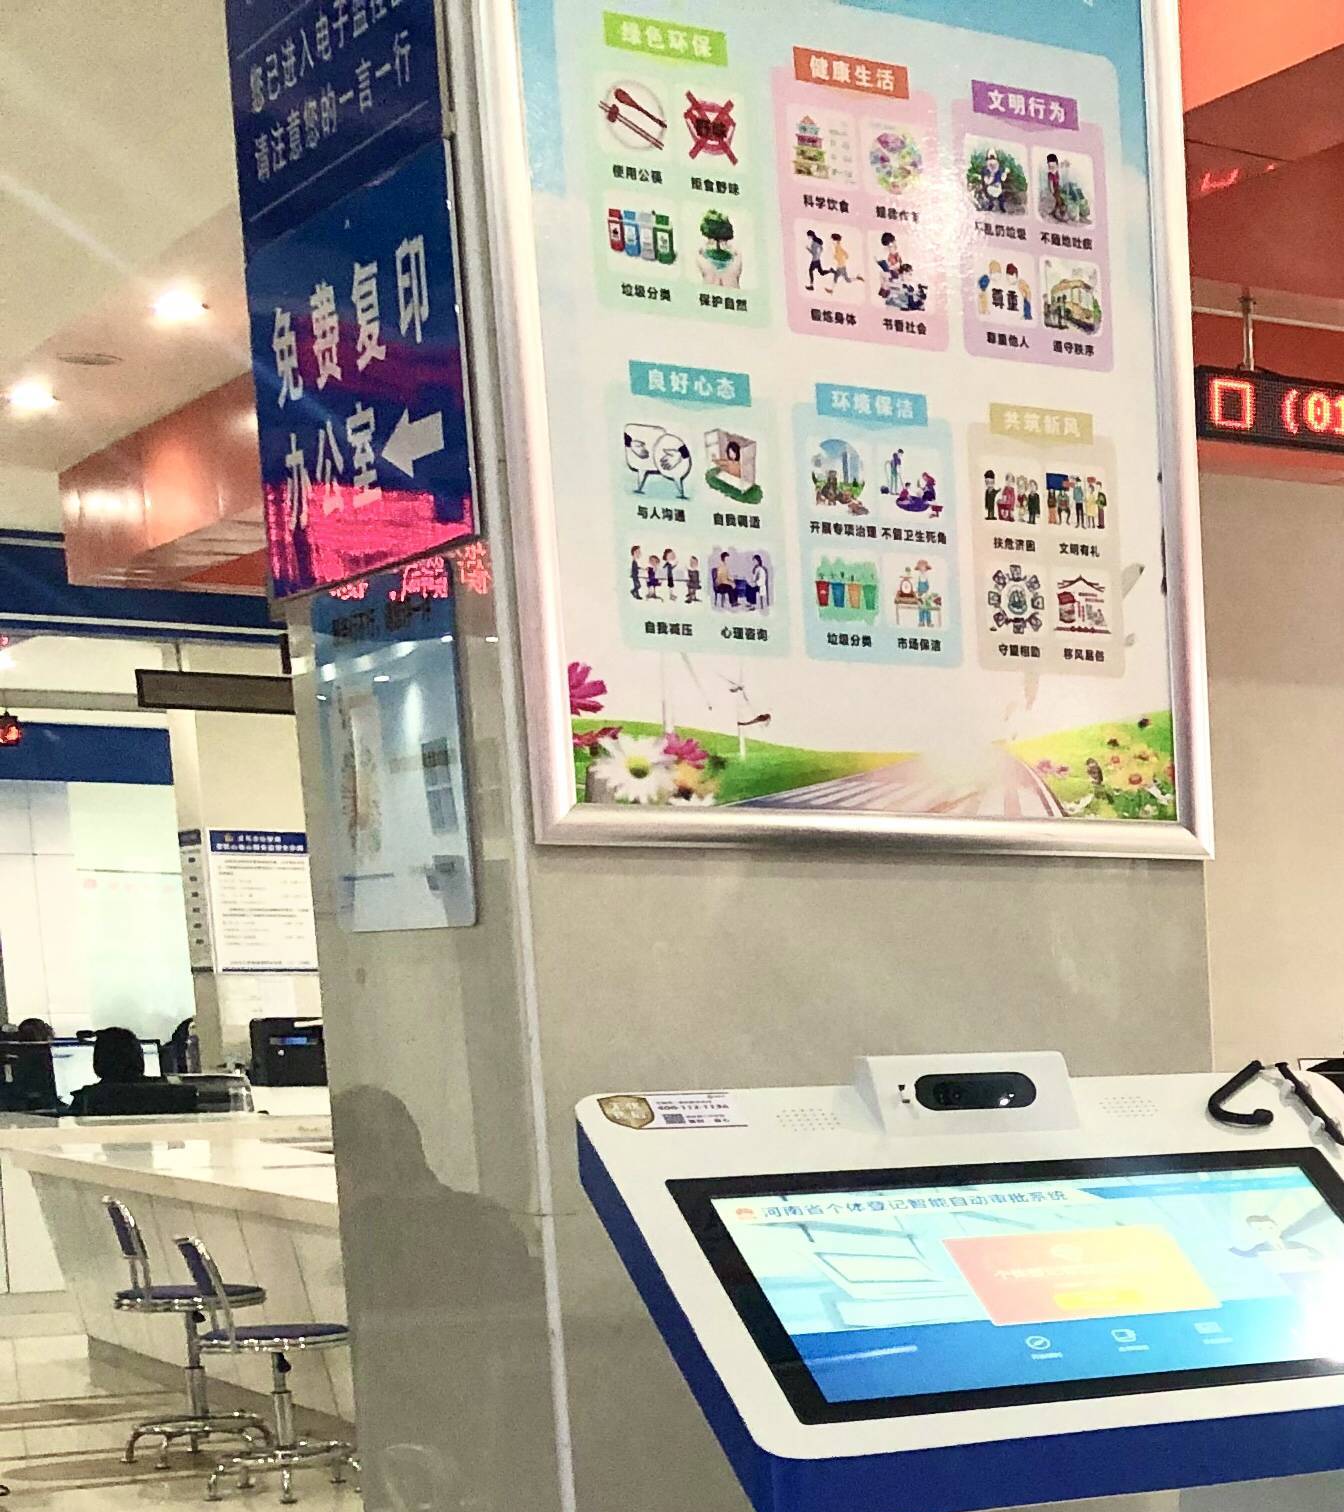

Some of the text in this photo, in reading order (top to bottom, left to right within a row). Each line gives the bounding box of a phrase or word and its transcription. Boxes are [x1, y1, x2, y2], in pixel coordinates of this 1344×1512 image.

[621, 21, 712, 57] 绿色环保
[809, 55, 896, 92] 健康生活
[255, 30, 411, 182] 请注意您的一言一行
[988, 90, 1066, 124] 文明行为
[612, 164, 664, 184] 使用公筷
[691, 177, 740, 196] 拒食野味
[802, 194, 850, 214] 科学饮食
[621, 283, 672, 302] 垃圾分类
[698, 293, 748, 312] 保护自然
[272, 234, 429, 408] 免费复印
[810, 308, 857, 327] 锻炼身体
[883, 319, 928, 335] 书香社会
[987, 332, 1030, 349] 尊重他人
[1052, 340, 1095, 357] 遵守秩序
[648, 369, 737, 400] 良好心态
[831, 390, 914, 419] 环境保洁
[1208, 376, 1256, 431] 口
[285, 401, 383, 530] 办公室
[637, 505, 686, 523] 与人沟通
[809, 520, 878, 540] 开展专项治理
[1059, 542, 1101, 558] 文明有礼
[645, 620, 693, 637] 自我减压
[720, 626, 768, 642] 心理咨询
[826, 632, 873, 648] 垃圾分类
